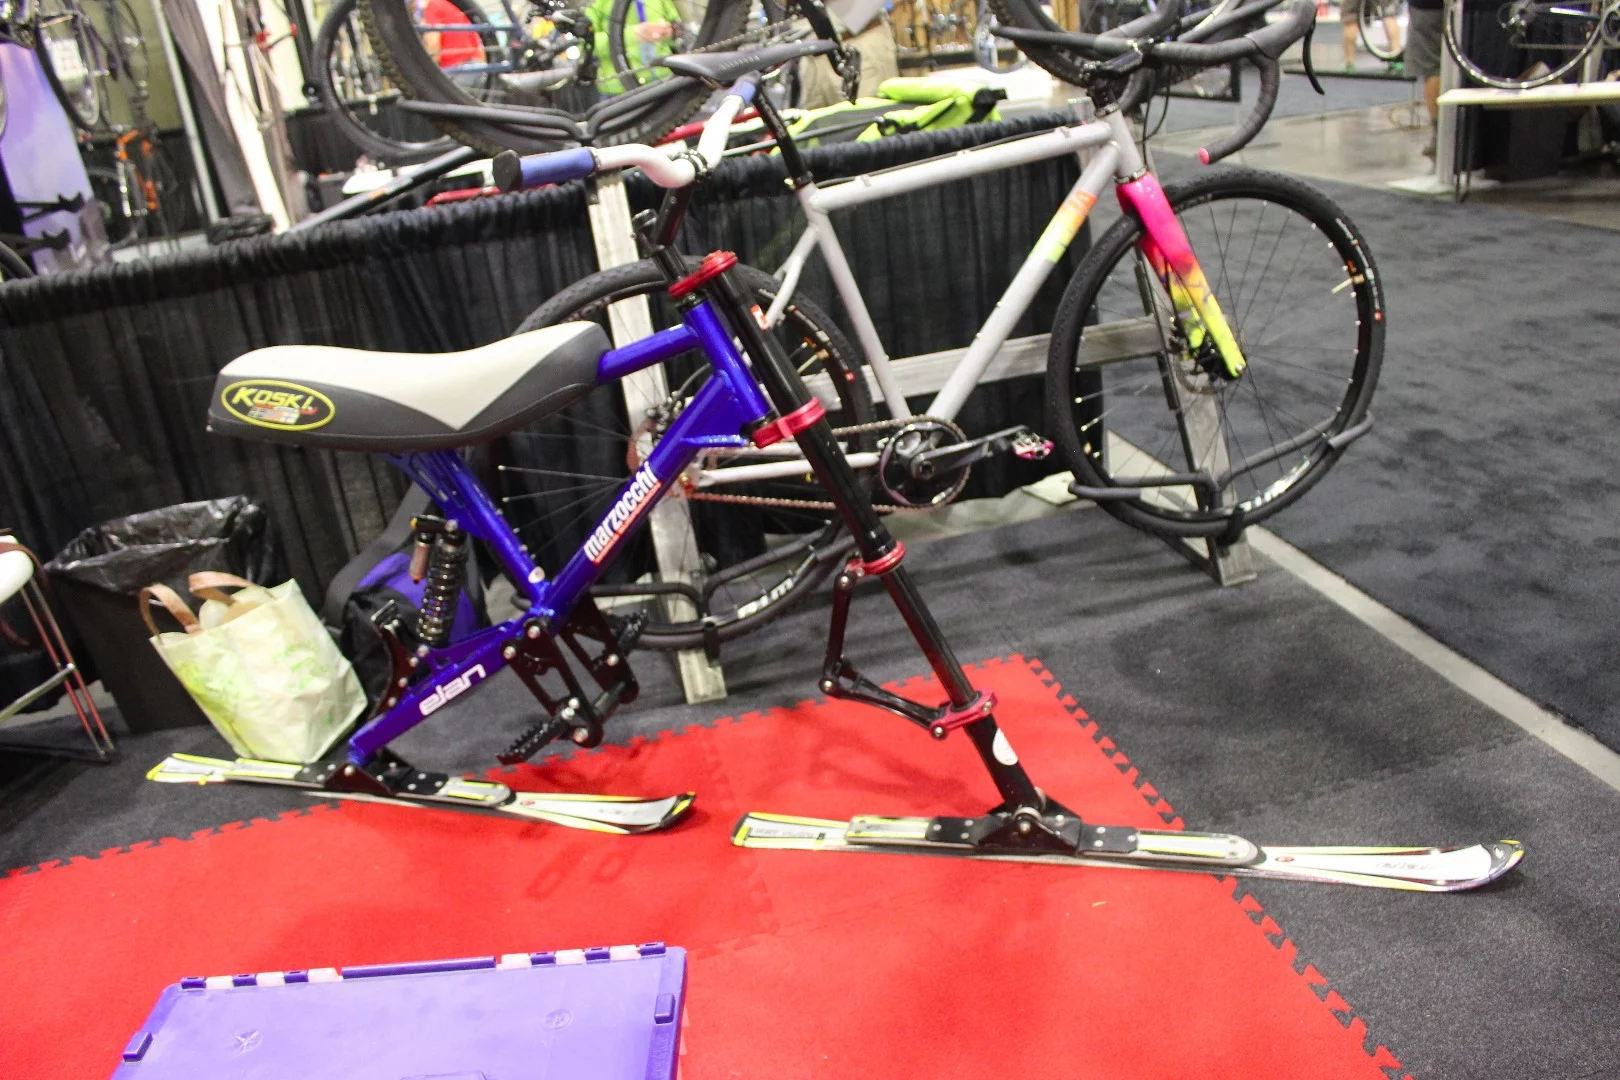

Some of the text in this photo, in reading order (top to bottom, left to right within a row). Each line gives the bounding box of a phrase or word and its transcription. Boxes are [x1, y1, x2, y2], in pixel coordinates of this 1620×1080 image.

[231, 386, 314, 410] KOSKI
[583, 460, 659, 562] marzocchi
[419, 663, 486, 716] elan
